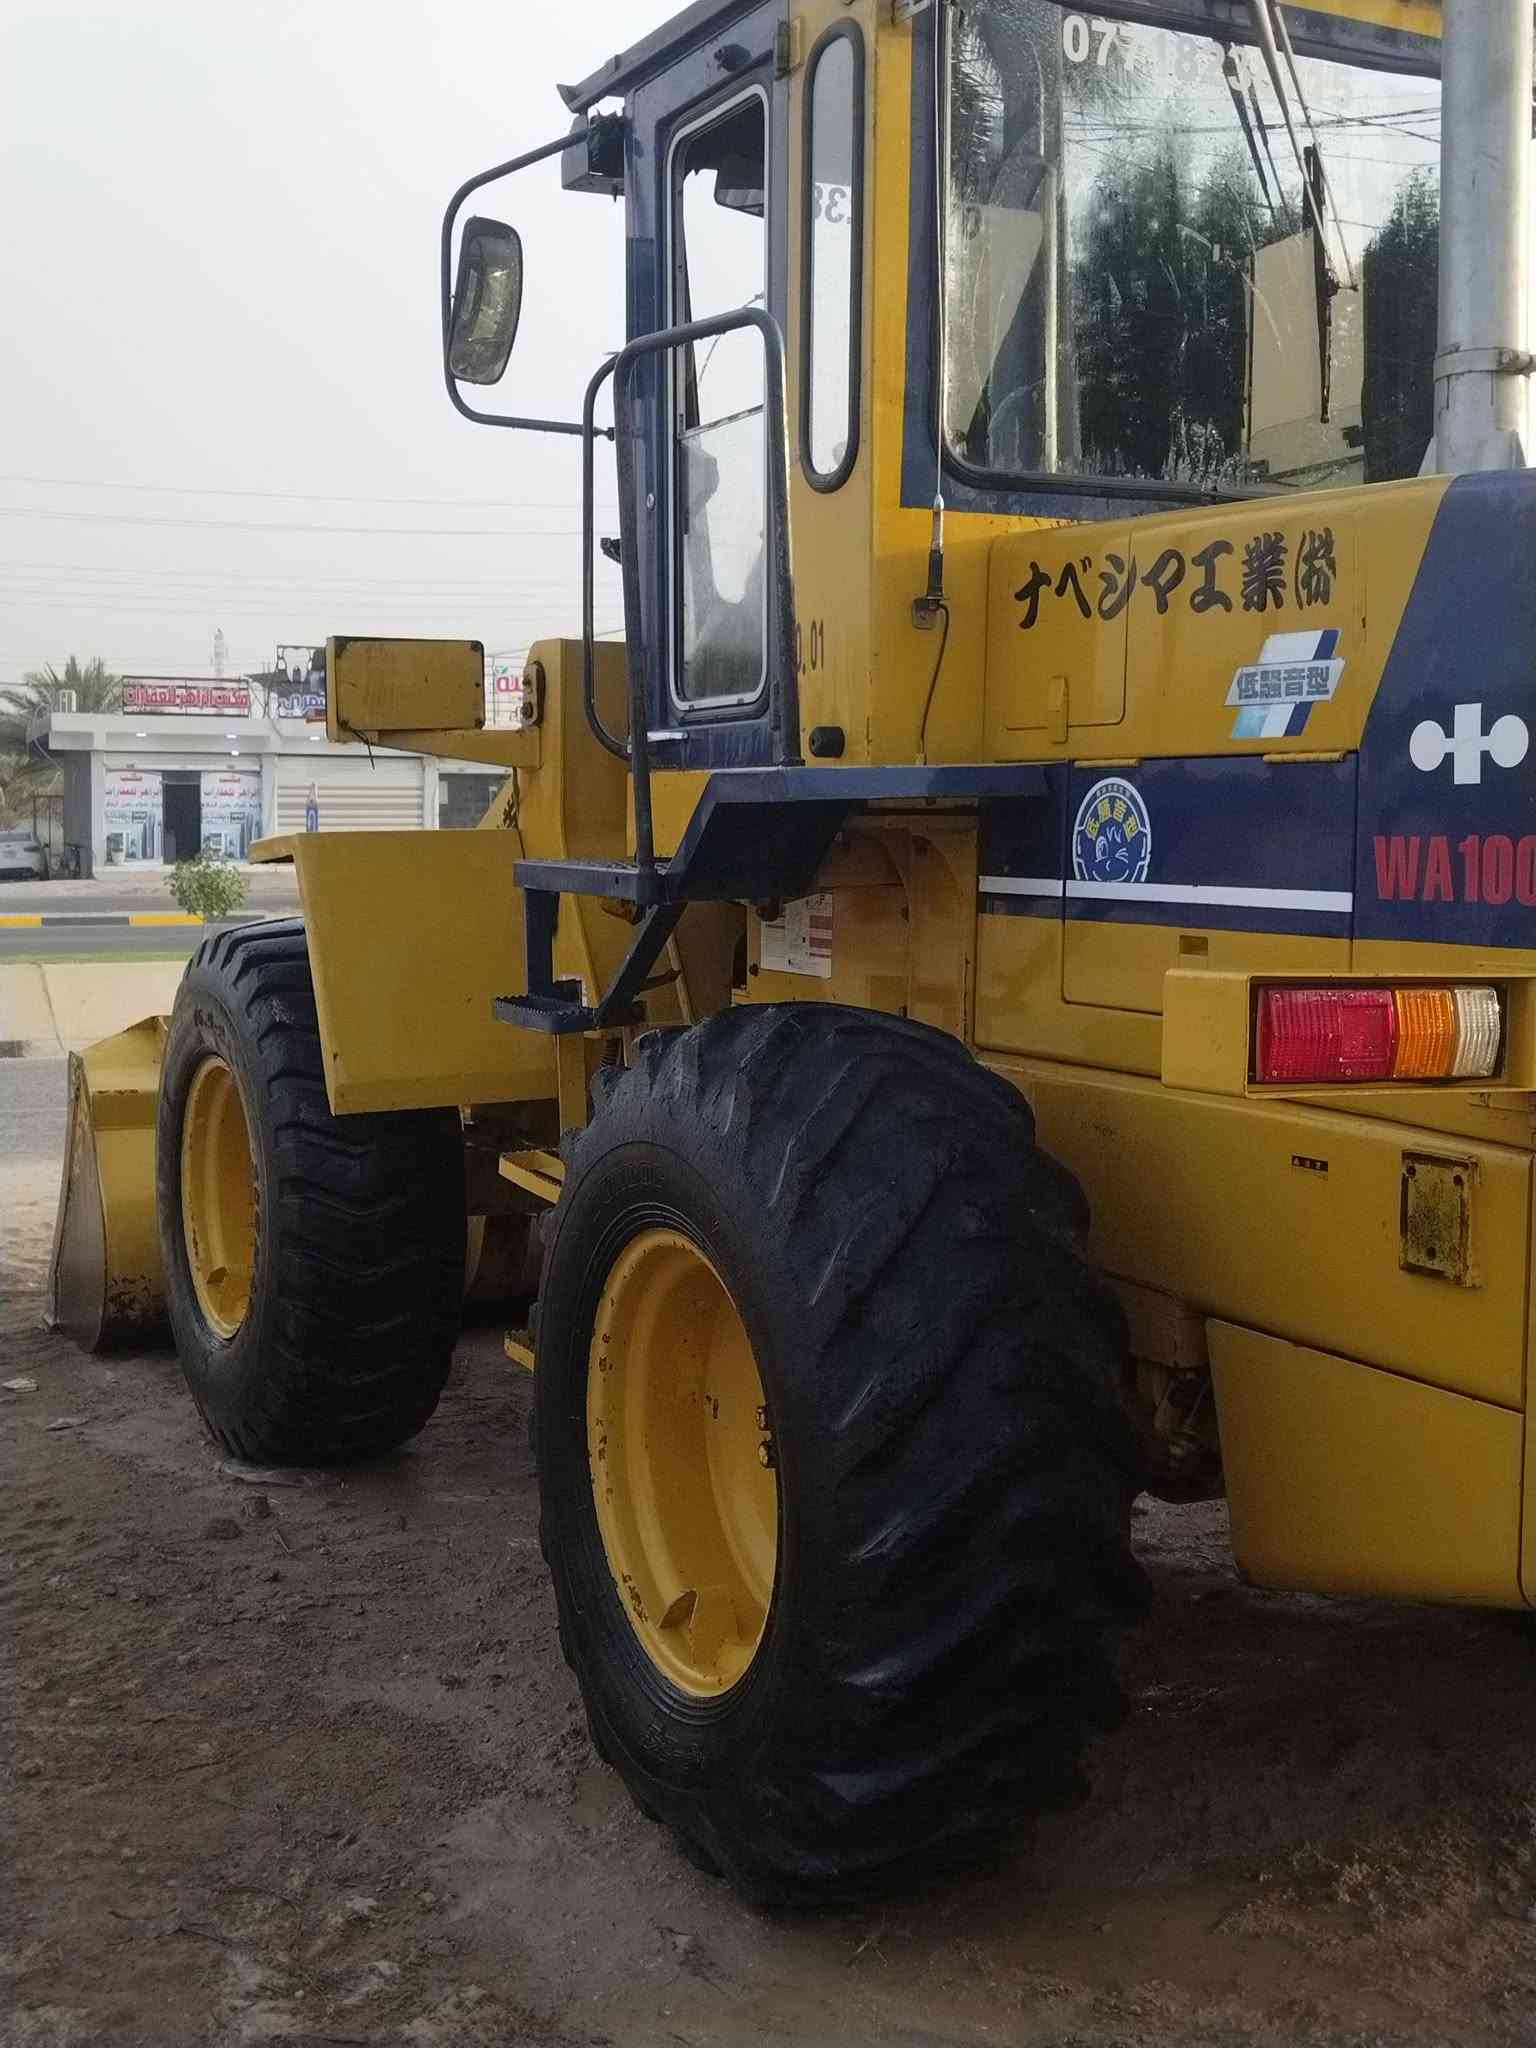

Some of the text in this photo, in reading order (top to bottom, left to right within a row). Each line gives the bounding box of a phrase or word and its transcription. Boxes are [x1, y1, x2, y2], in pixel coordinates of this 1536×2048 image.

[1237, 665, 1330, 700] 低騒音型
[1374, 833, 1536, 906] WA100
